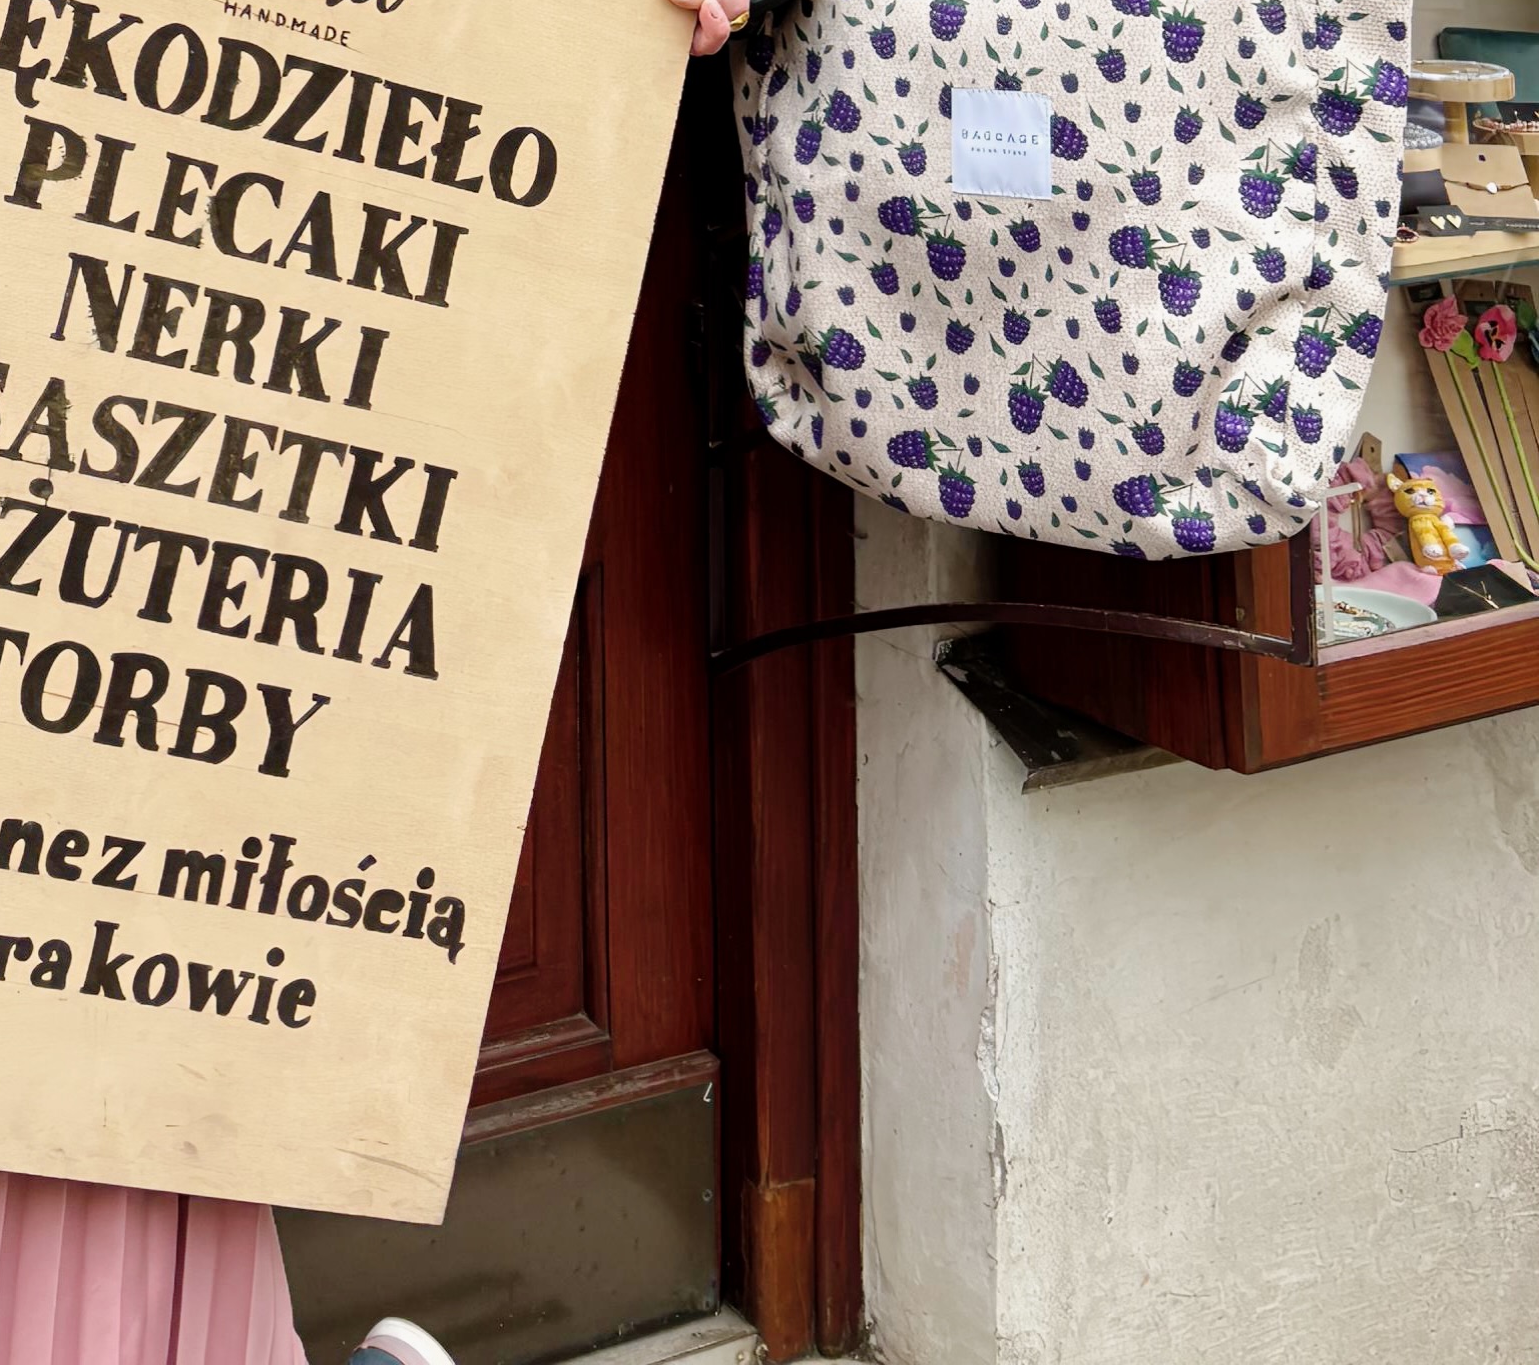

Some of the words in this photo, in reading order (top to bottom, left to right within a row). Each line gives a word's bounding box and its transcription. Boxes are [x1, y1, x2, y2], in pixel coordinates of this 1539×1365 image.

[223, 0, 351, 47] HANDMADE
[4, 114, 469, 308] PLECAKI
[50, 252, 390, 410] NERKI
[91, 835, 147, 891] z
[157, 833, 467, 965] miłością
